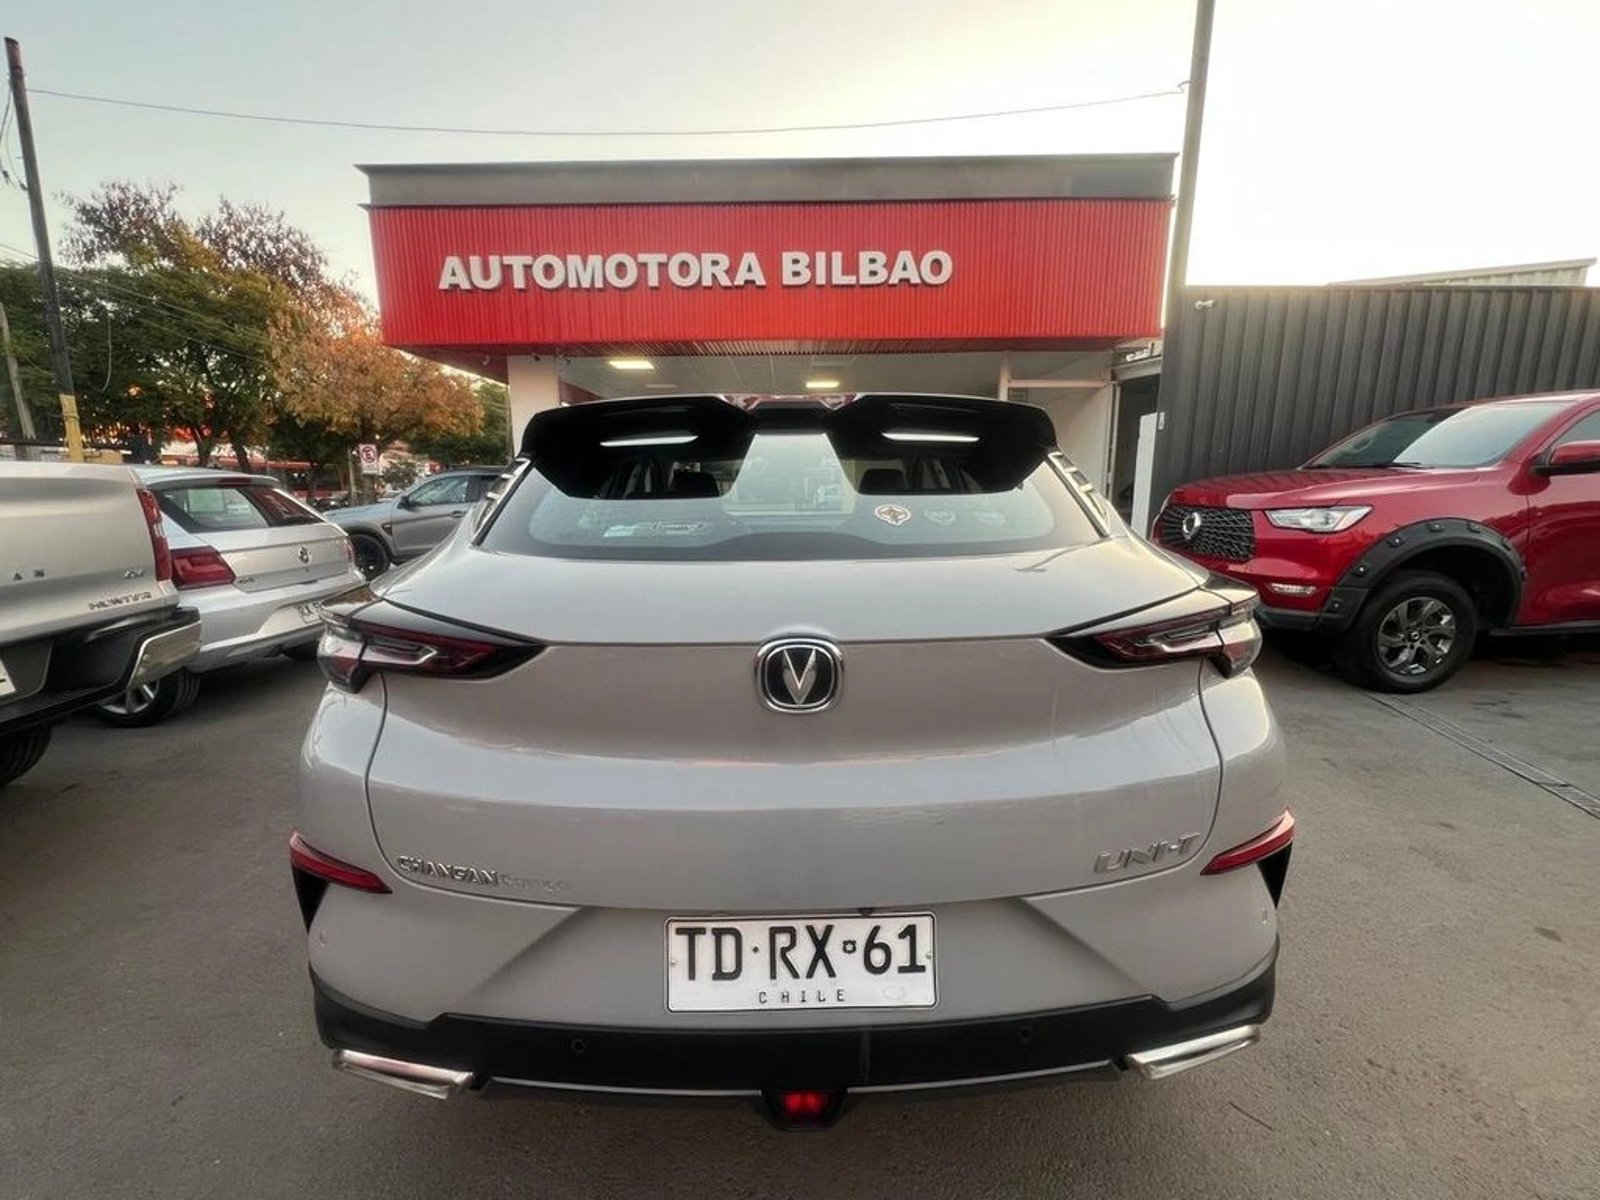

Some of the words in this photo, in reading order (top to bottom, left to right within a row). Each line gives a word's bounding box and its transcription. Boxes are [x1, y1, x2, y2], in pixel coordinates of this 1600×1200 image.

[438, 252, 766, 290] AUTOMOTORA
[782, 249, 953, 286] BILBAO
[397, 854, 499, 887] CHANGAN
[758, 988, 846, 1004] CHILE
